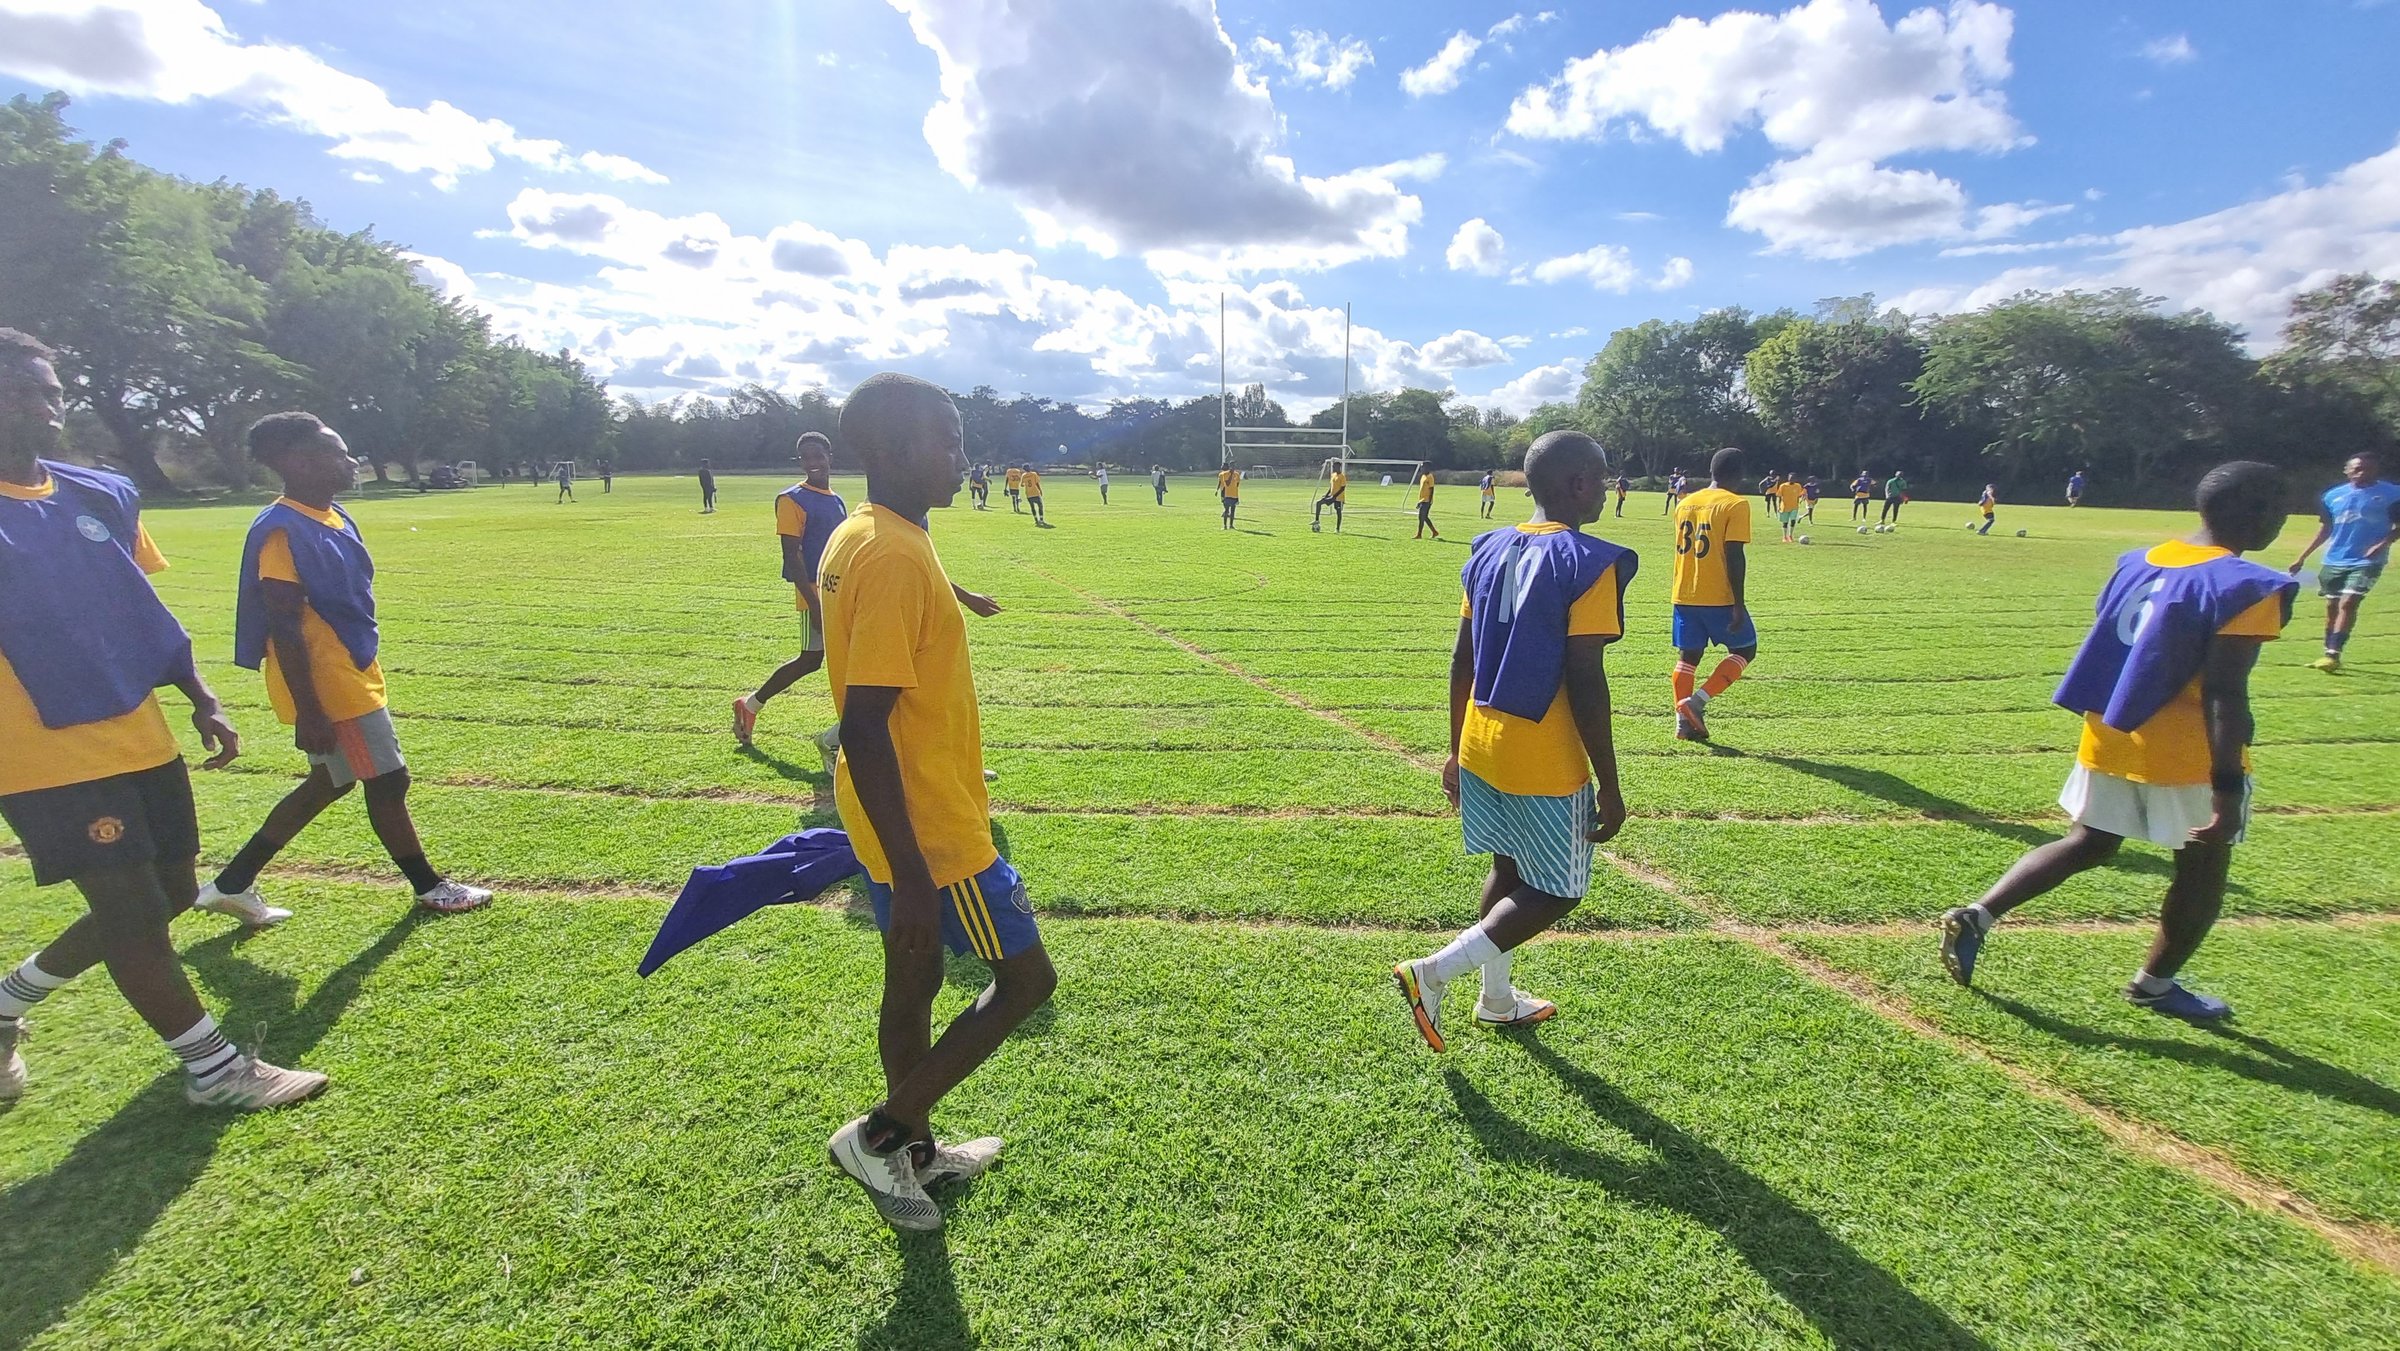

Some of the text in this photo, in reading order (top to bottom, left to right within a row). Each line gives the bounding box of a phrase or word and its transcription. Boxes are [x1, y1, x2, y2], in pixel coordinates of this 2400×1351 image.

[1676, 520, 1711, 558] 35
[822, 572, 840, 593] ASE
[2117, 578, 2166, 646] 6
